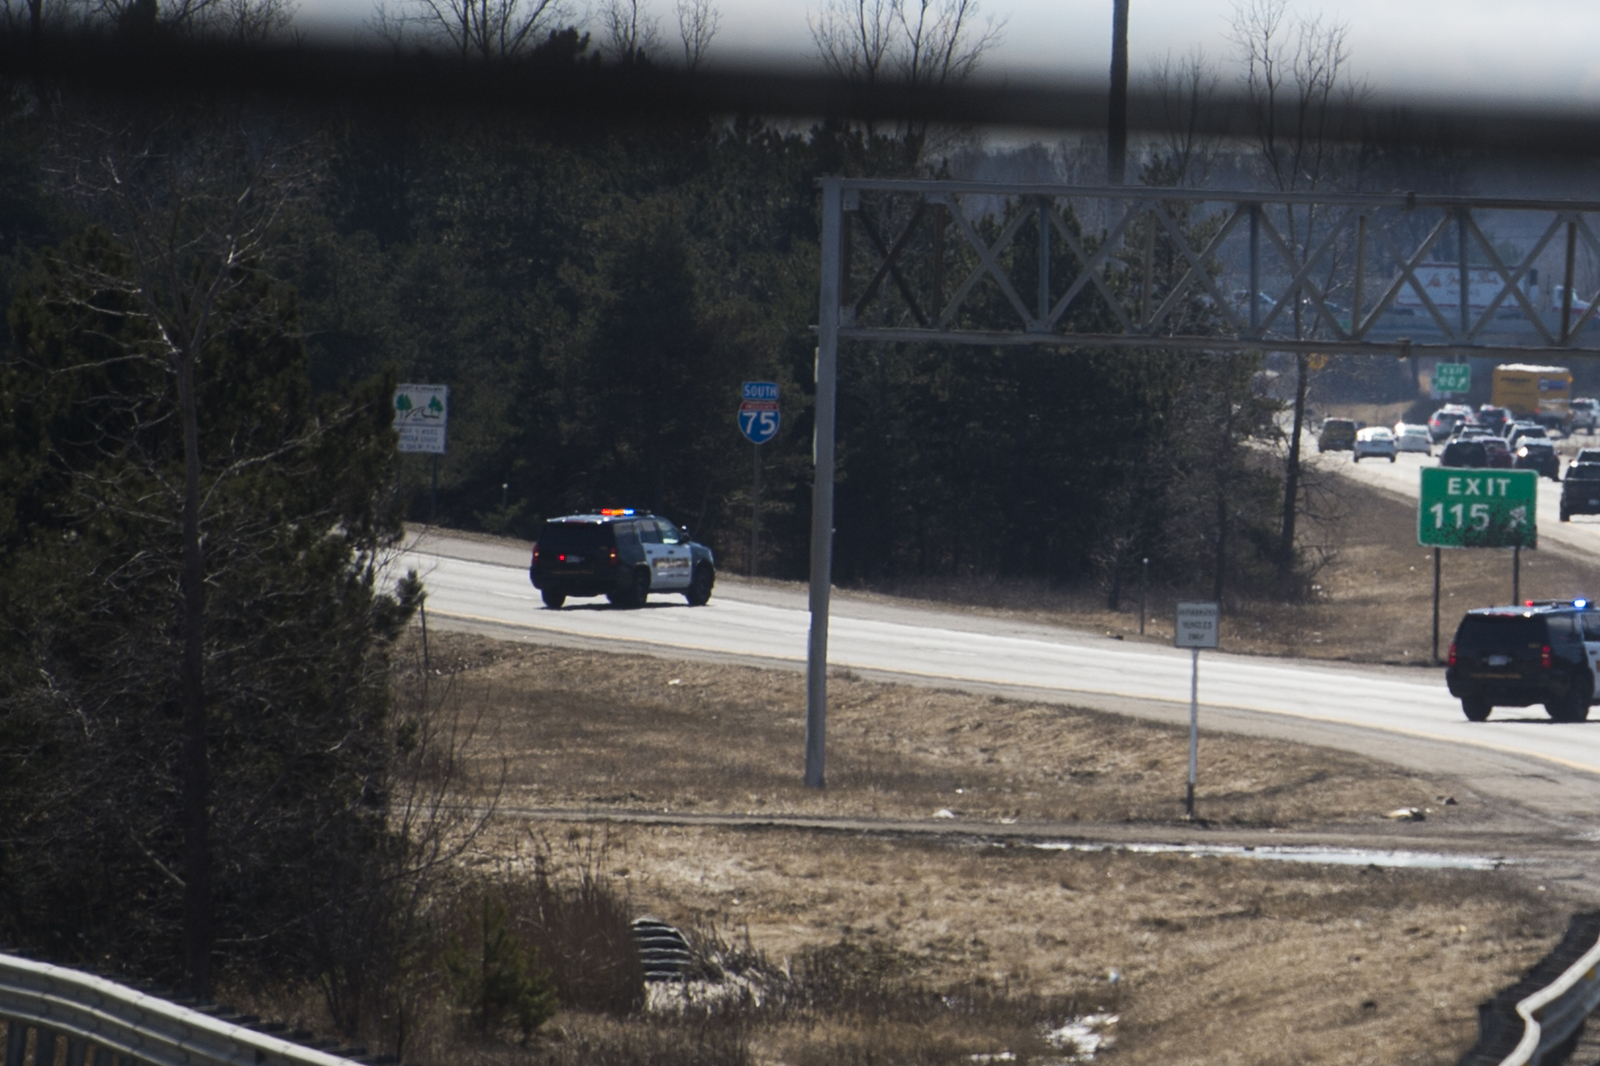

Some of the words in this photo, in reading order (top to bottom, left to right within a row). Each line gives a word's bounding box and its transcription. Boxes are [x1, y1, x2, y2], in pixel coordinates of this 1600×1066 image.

[744, 385, 777, 397] SOUTH
[742, 412, 776, 435] 75
[1447, 477, 1511, 497] EXIT
[1430, 503, 1490, 531] 115
